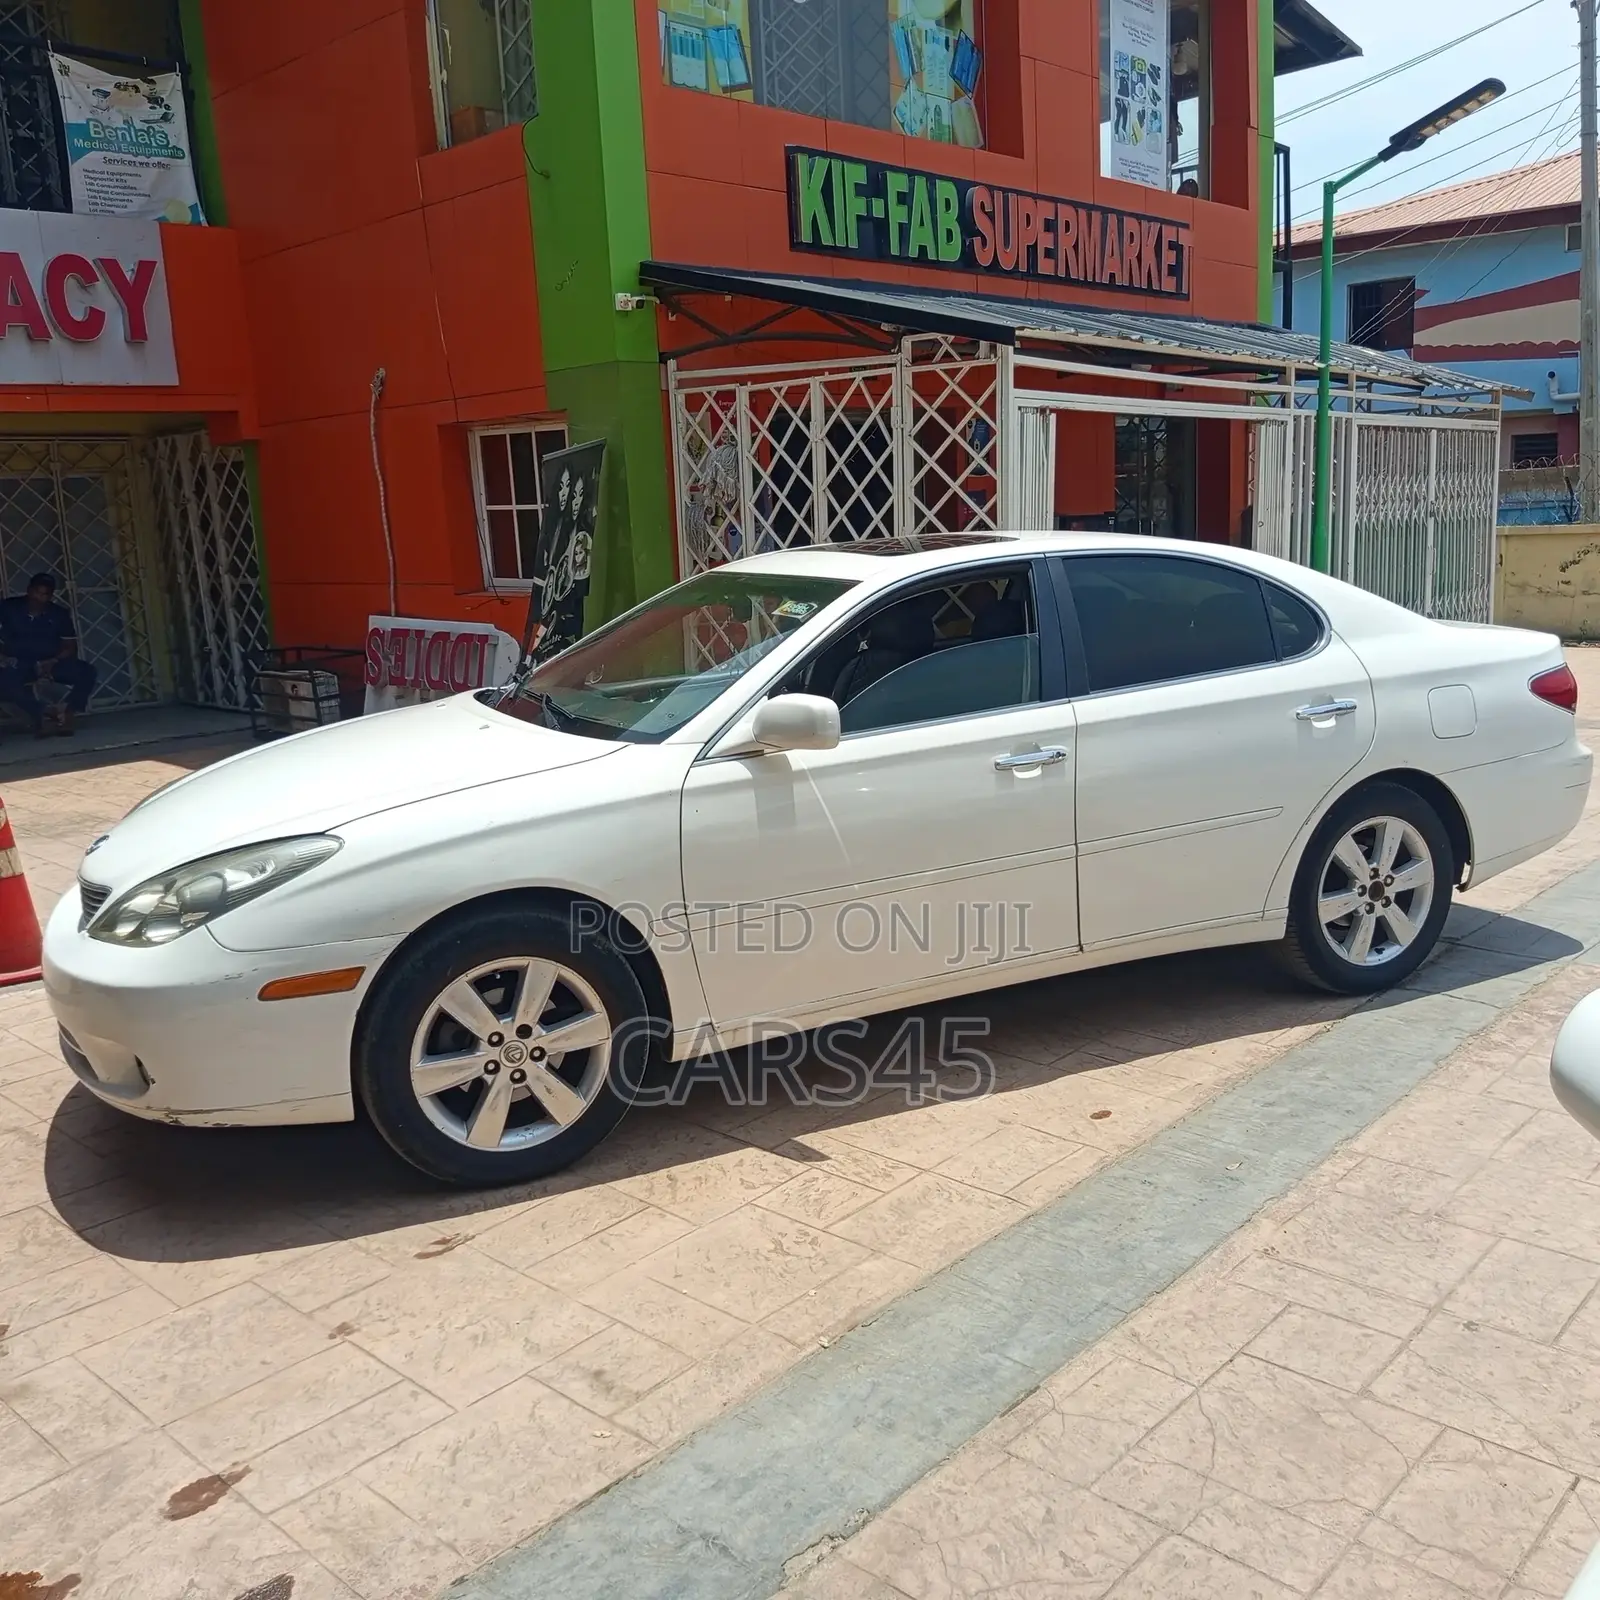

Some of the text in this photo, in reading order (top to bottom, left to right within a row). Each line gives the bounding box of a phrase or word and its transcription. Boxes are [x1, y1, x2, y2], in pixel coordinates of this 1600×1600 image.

[74, 138, 184, 158] Medical Equipments
[82, 167, 106, 175] Medical
[102, 156, 137, 167] Services
[794, 152, 1195, 295] KIF-FAB SUPERMARKET
[0, 251, 158, 343] ACY
